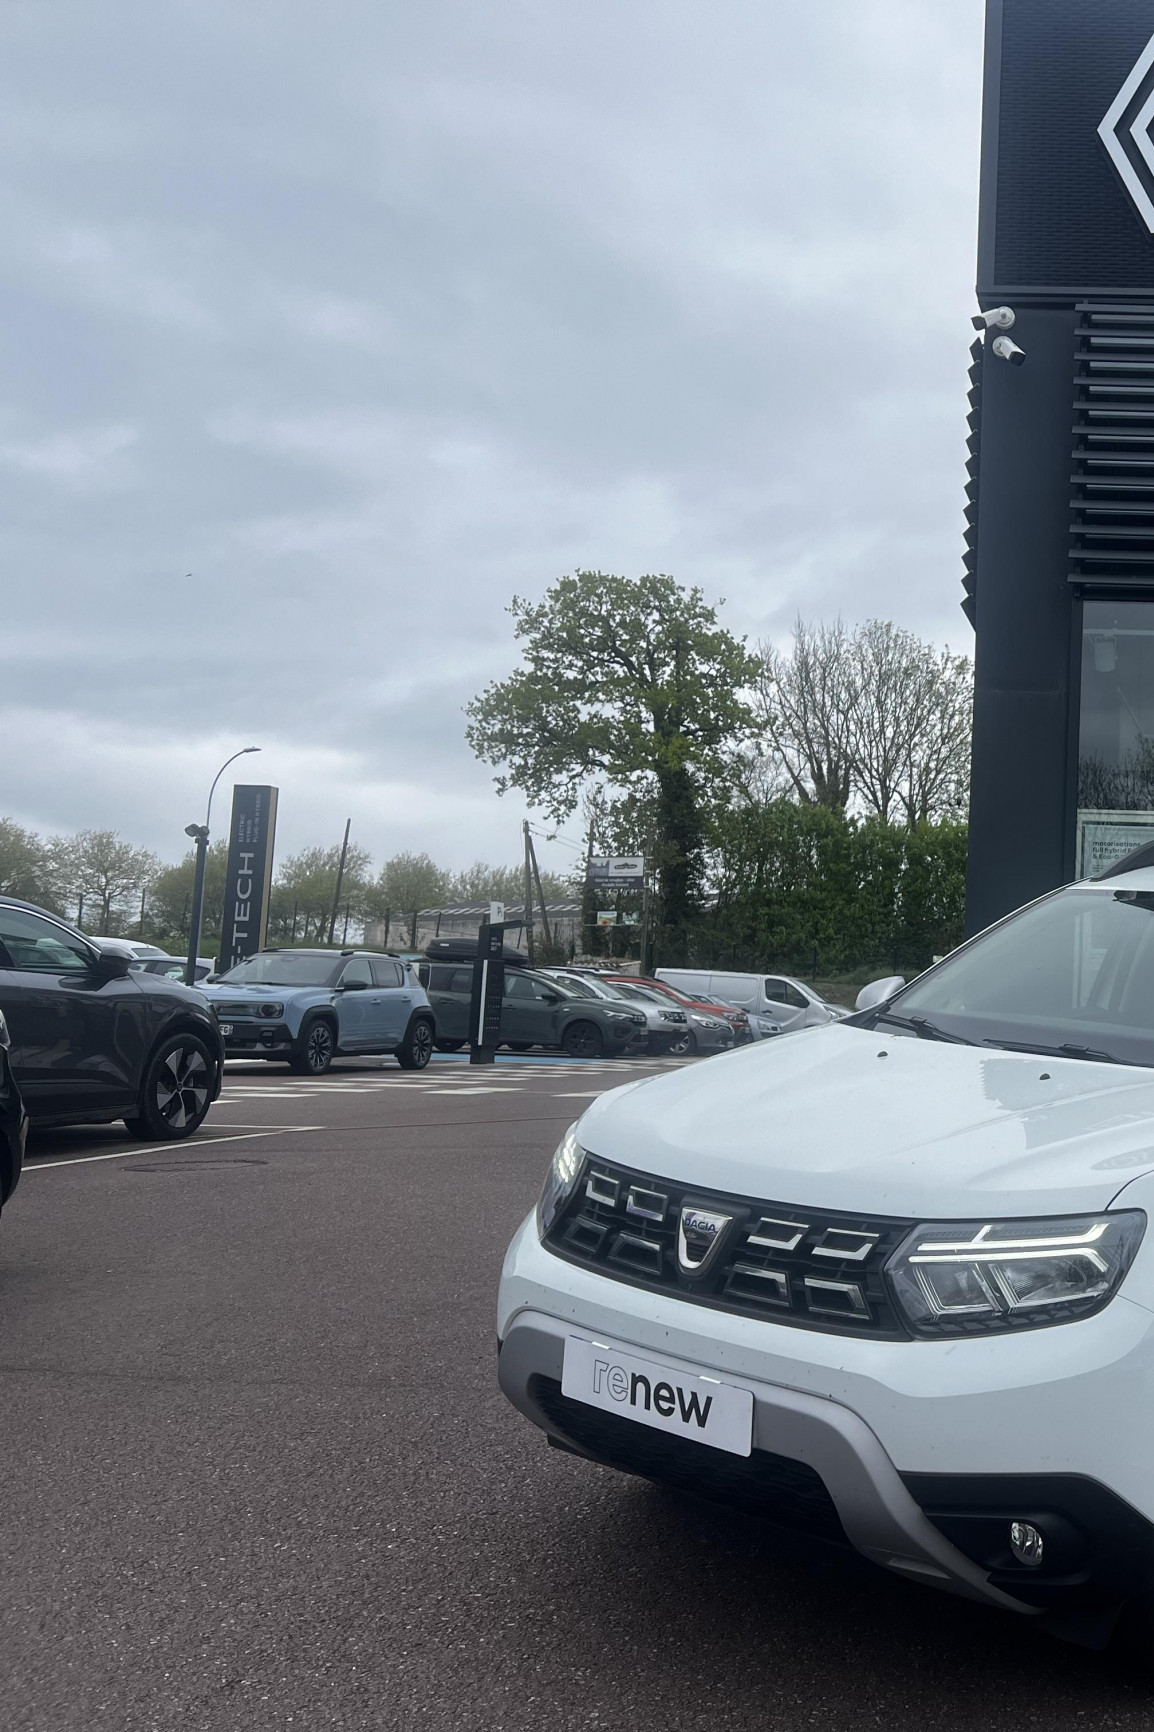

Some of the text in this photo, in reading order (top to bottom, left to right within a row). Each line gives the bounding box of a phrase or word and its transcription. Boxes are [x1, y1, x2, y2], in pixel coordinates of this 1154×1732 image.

[238, 813, 246, 843] ELECTRIC
[1104, 847, 1127, 855] hybrid
[685, 1218, 717, 1232] DACIA
[593, 1359, 713, 1429] renew
